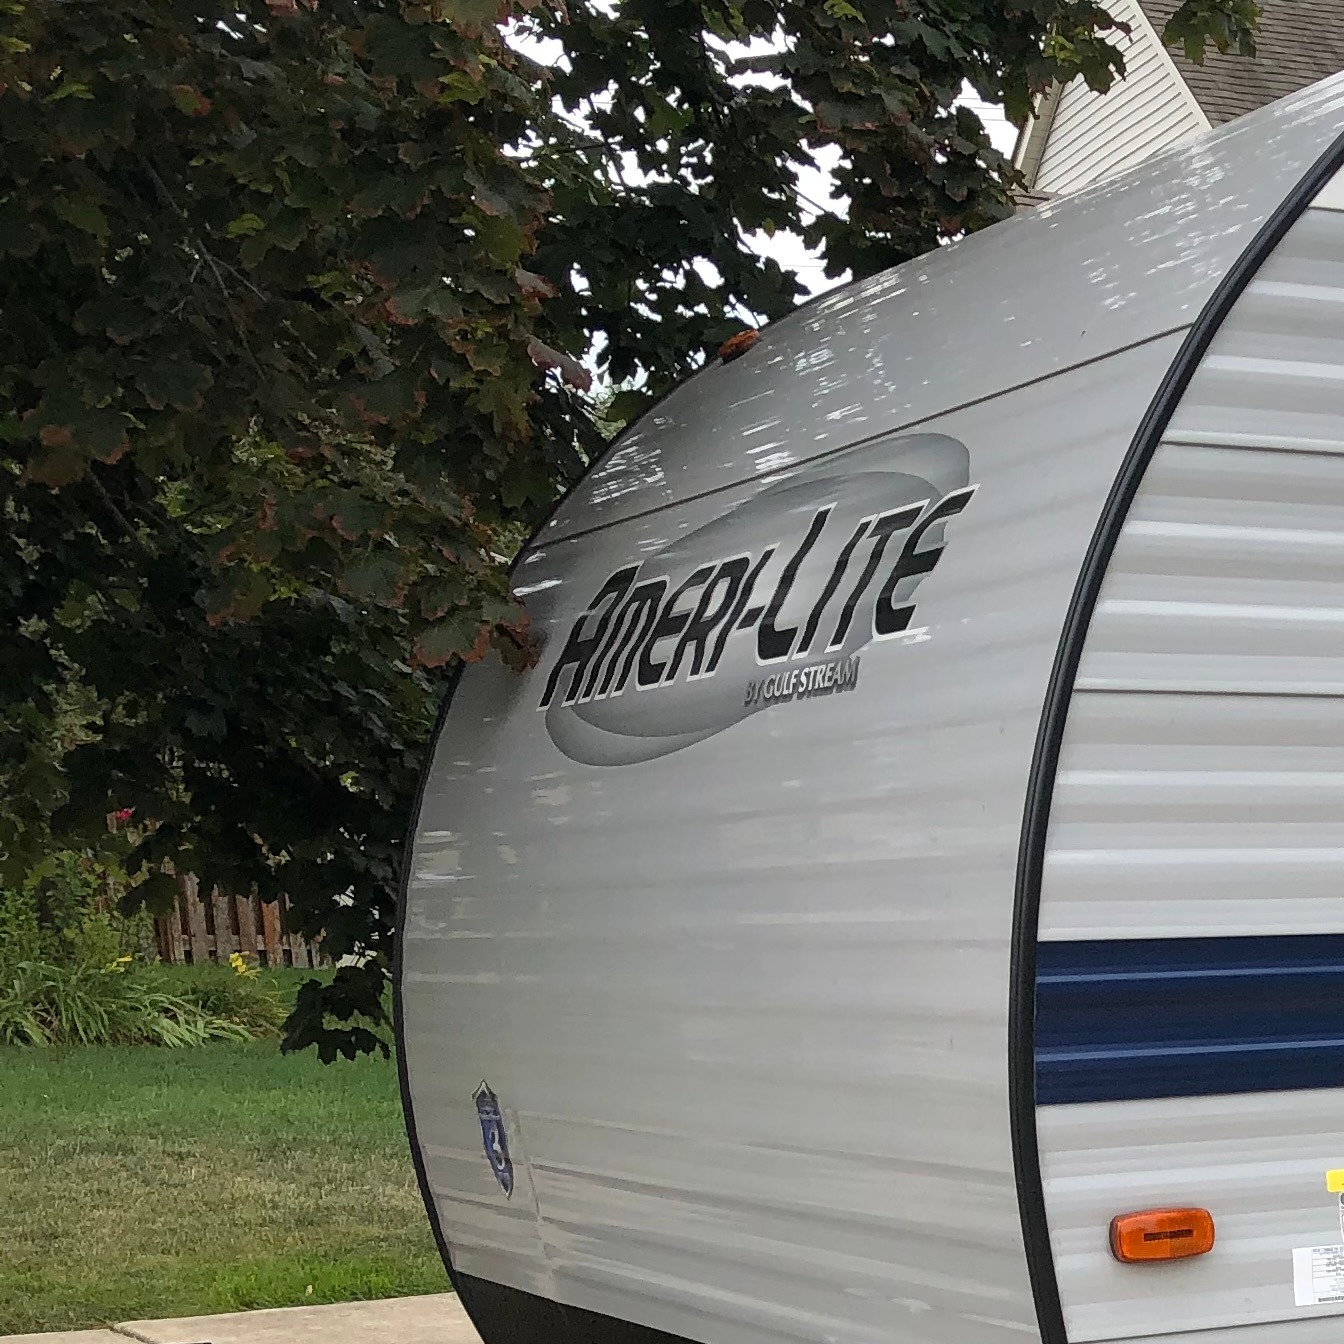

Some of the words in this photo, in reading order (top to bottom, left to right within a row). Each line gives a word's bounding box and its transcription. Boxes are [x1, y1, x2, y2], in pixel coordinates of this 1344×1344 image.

[537, 484, 980, 711] AMERI-LITE
[763, 669, 799, 700] GULF
[797, 656, 860, 694] STREAM
